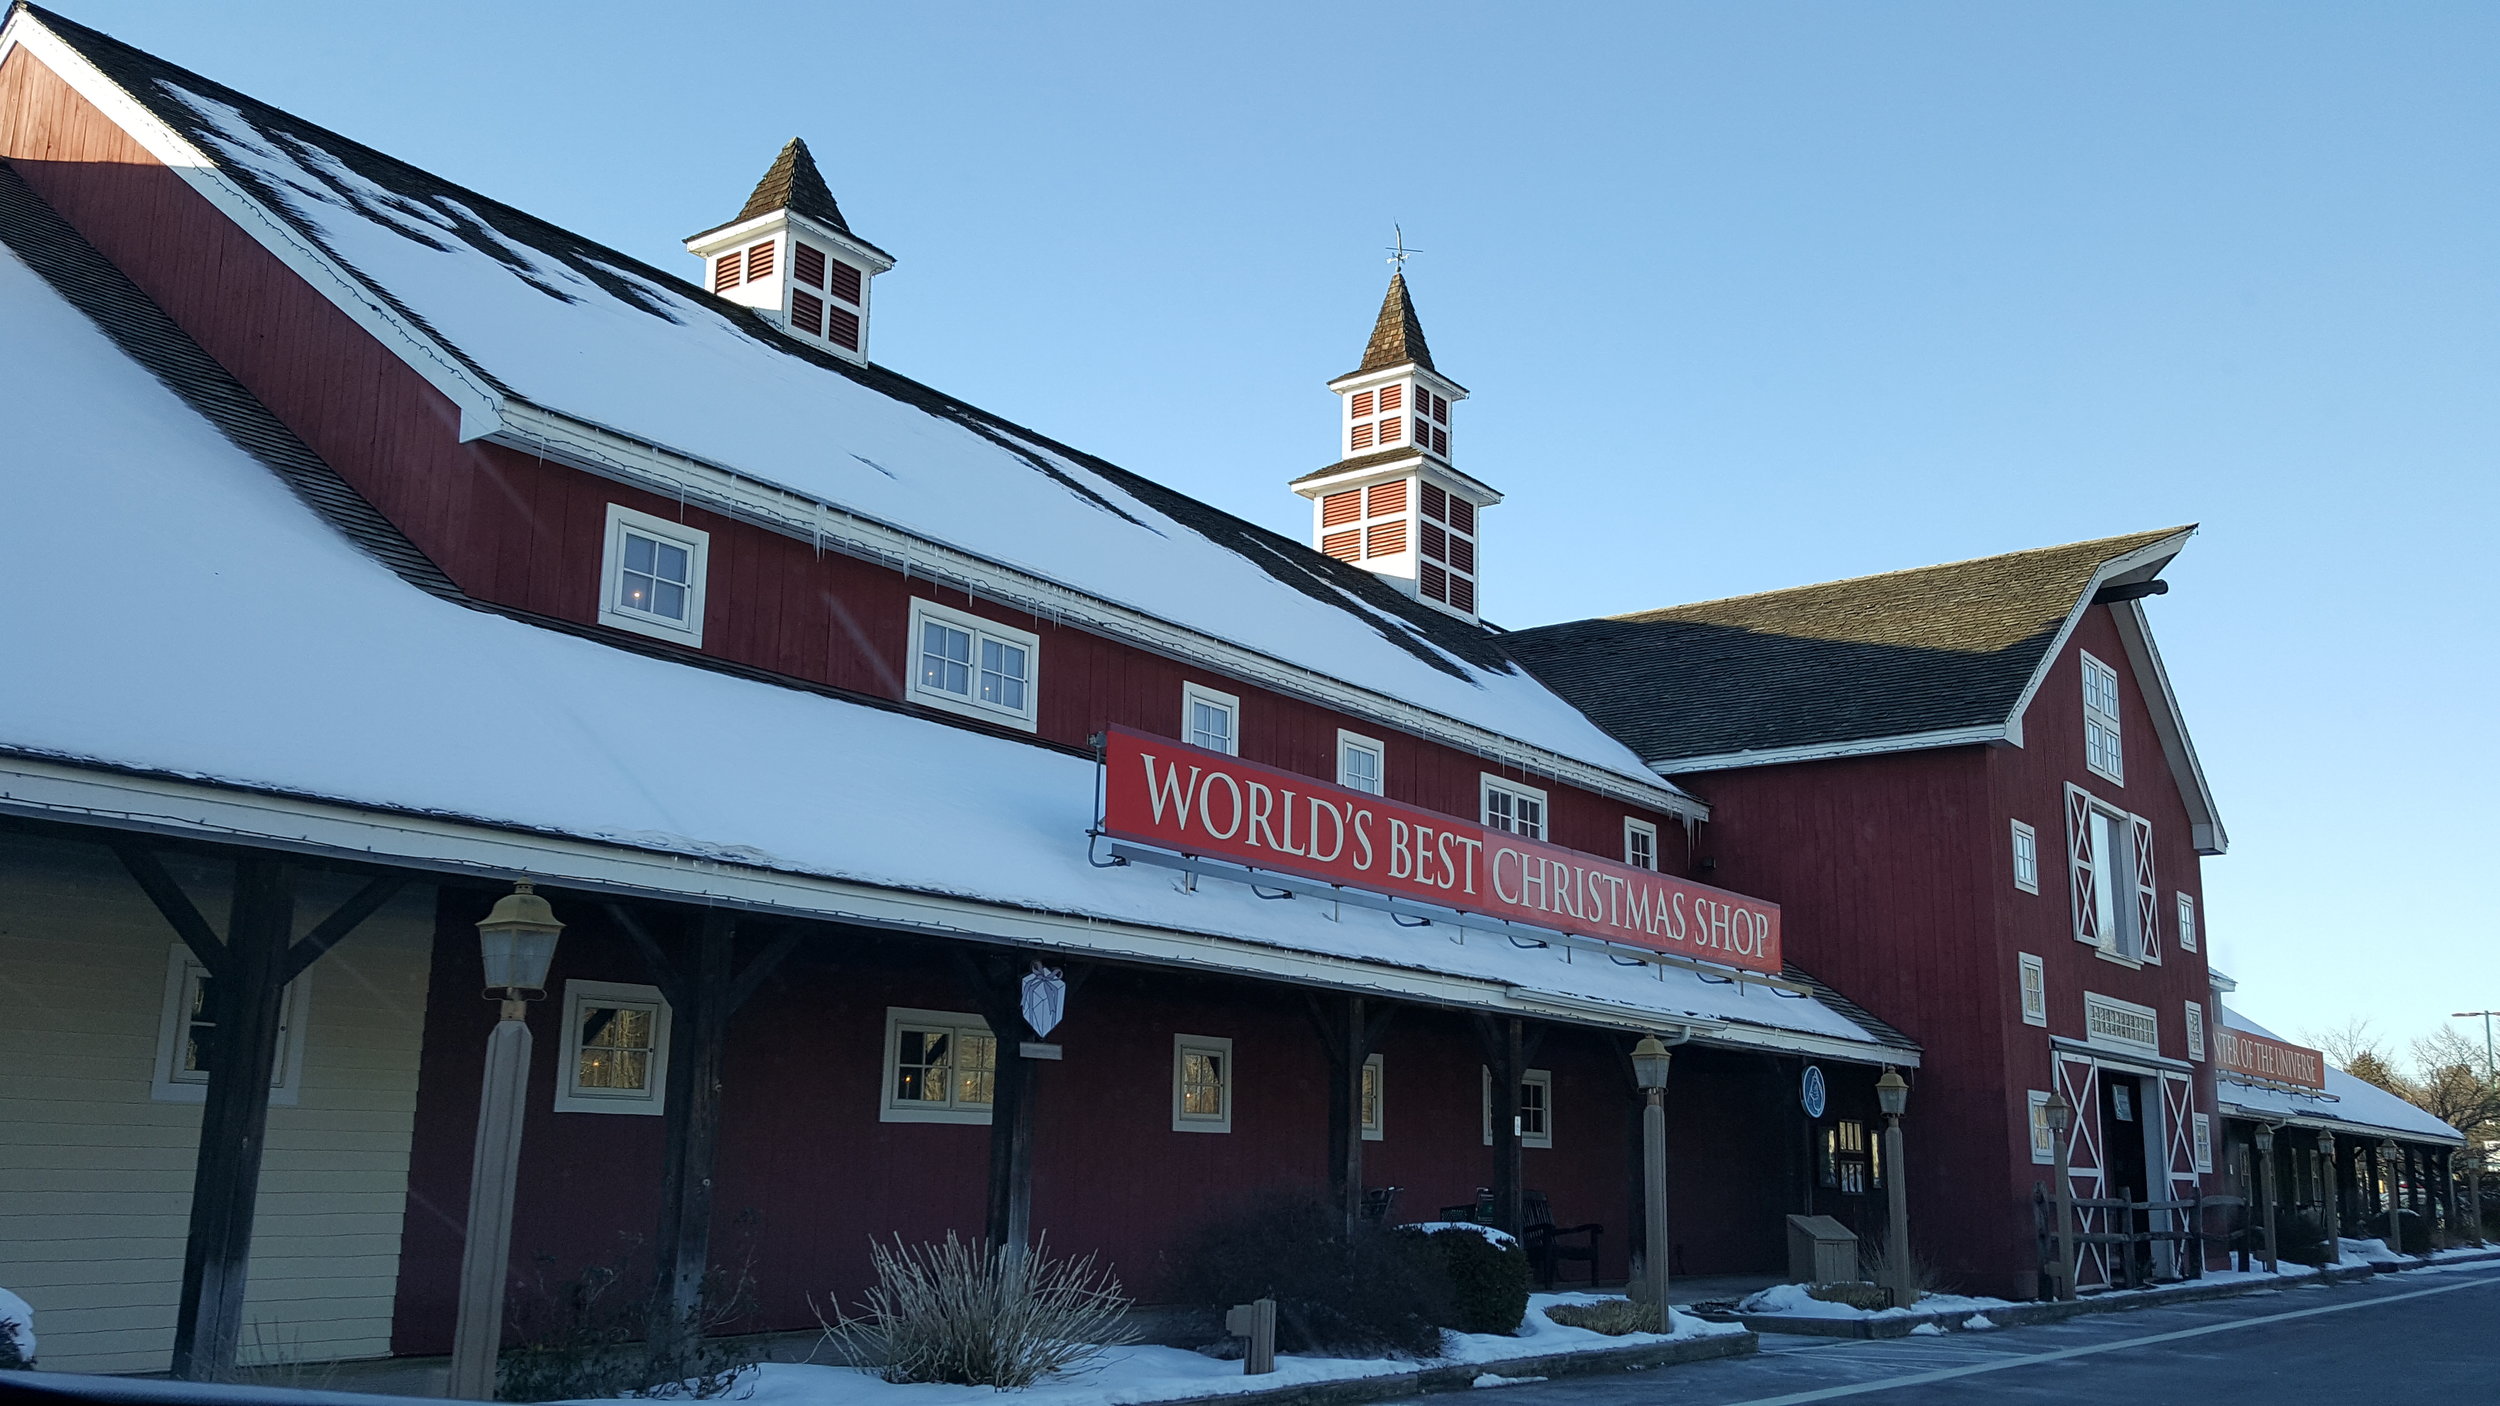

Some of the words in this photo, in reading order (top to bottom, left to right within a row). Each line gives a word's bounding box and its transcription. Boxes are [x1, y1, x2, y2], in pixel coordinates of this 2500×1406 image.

[1140, 753, 1373, 871] WORLD'S
[1387, 817, 1482, 895] BEST
[1492, 847, 1686, 941] CHRISTMAS
[1694, 897, 1768, 958] SHOP
[2213, 1032, 2240, 1067] NTER
[2240, 1038, 2253, 1069] OF
[2254, 1043, 2275, 1074] THE
[2274, 1047, 2316, 1082] UNIVERSE
